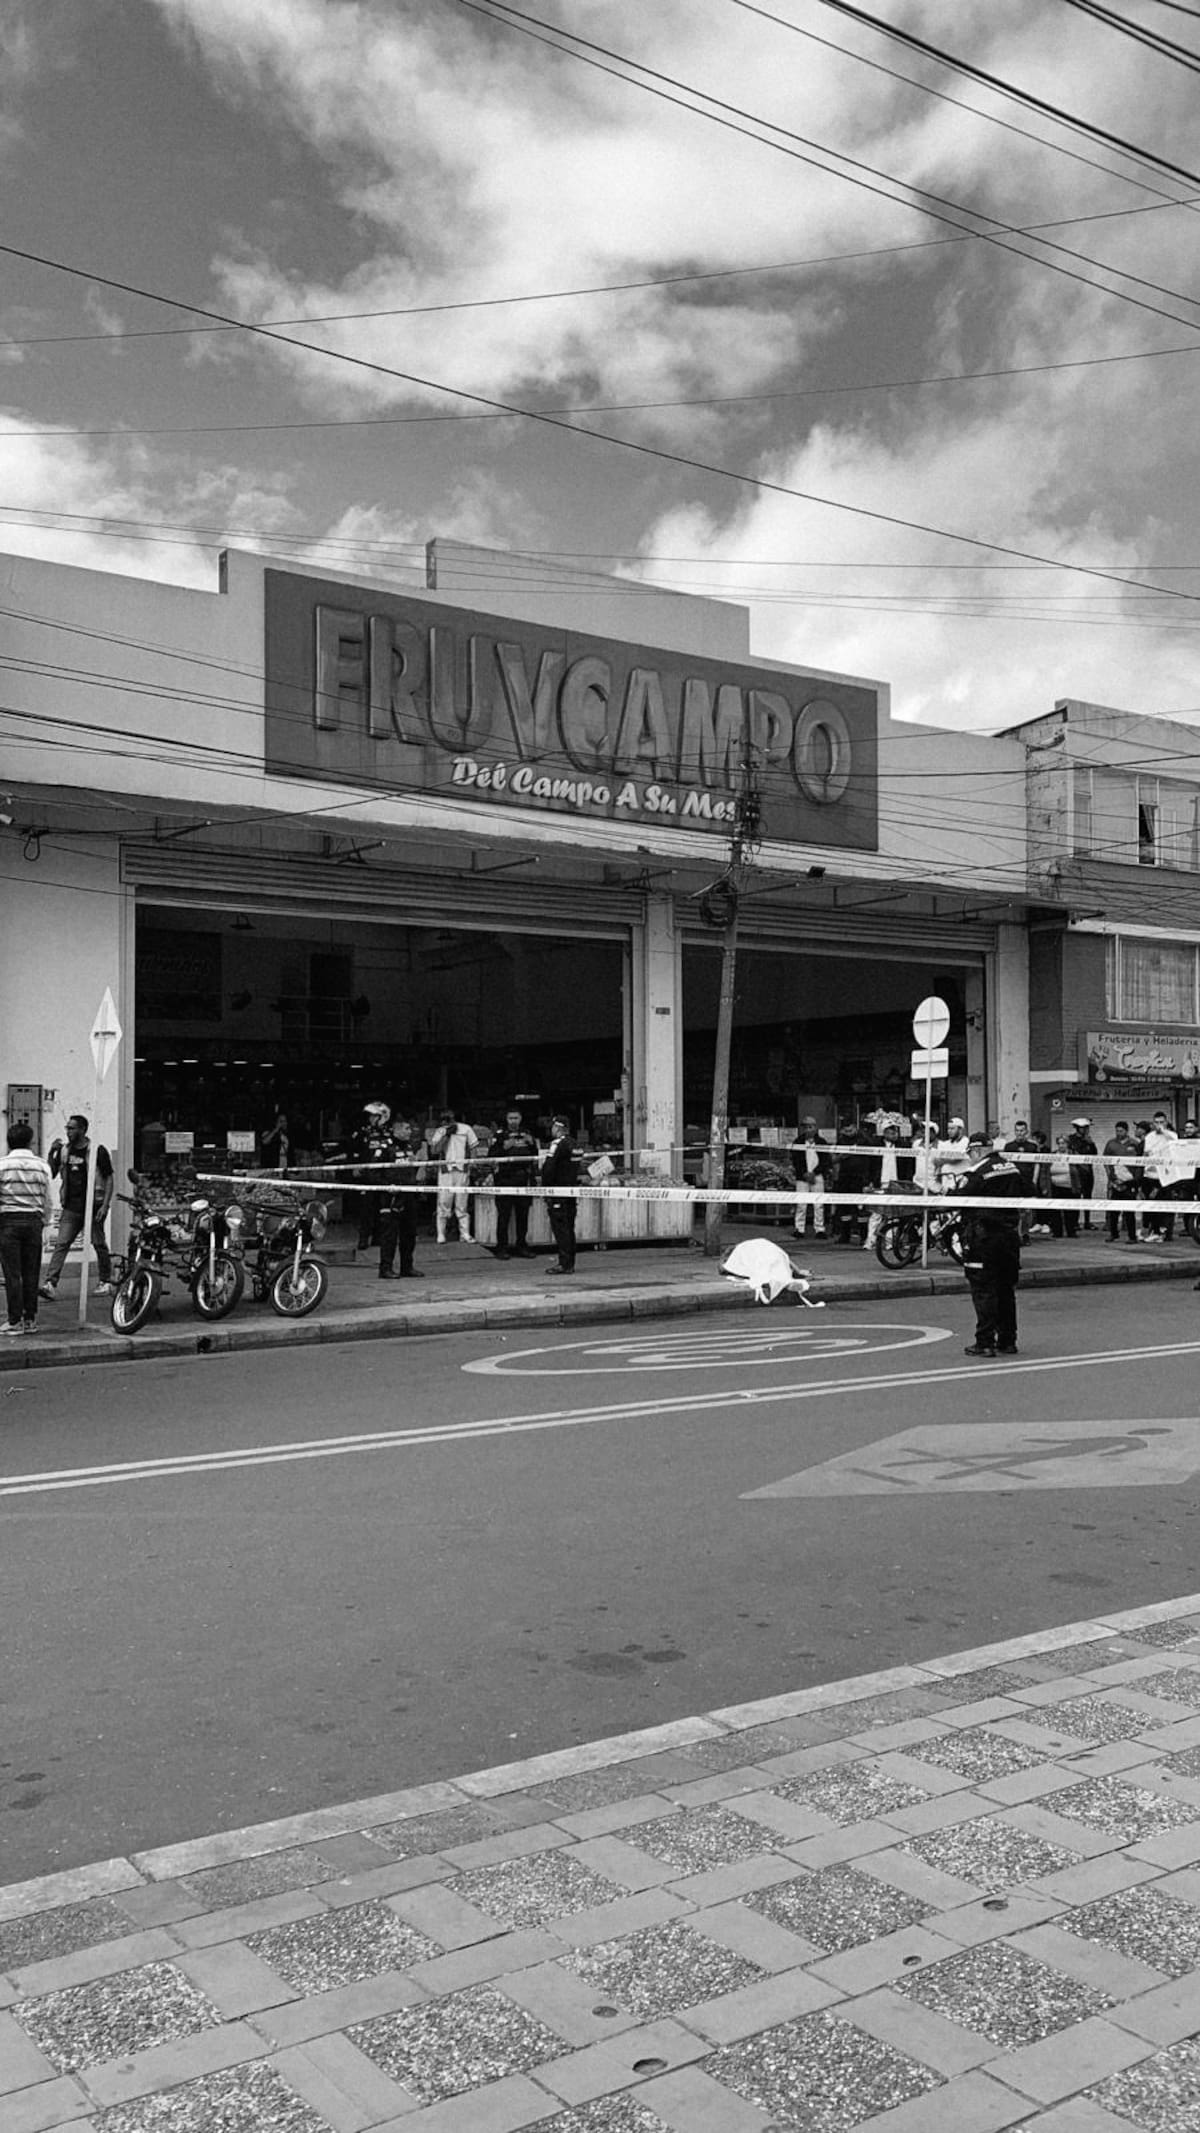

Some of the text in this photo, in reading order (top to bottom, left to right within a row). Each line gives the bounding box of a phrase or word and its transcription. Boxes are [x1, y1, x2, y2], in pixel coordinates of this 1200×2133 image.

[451, 757, 738, 823] Del Campo A Su Mes
[1143, 1037, 1151, 1046] y
